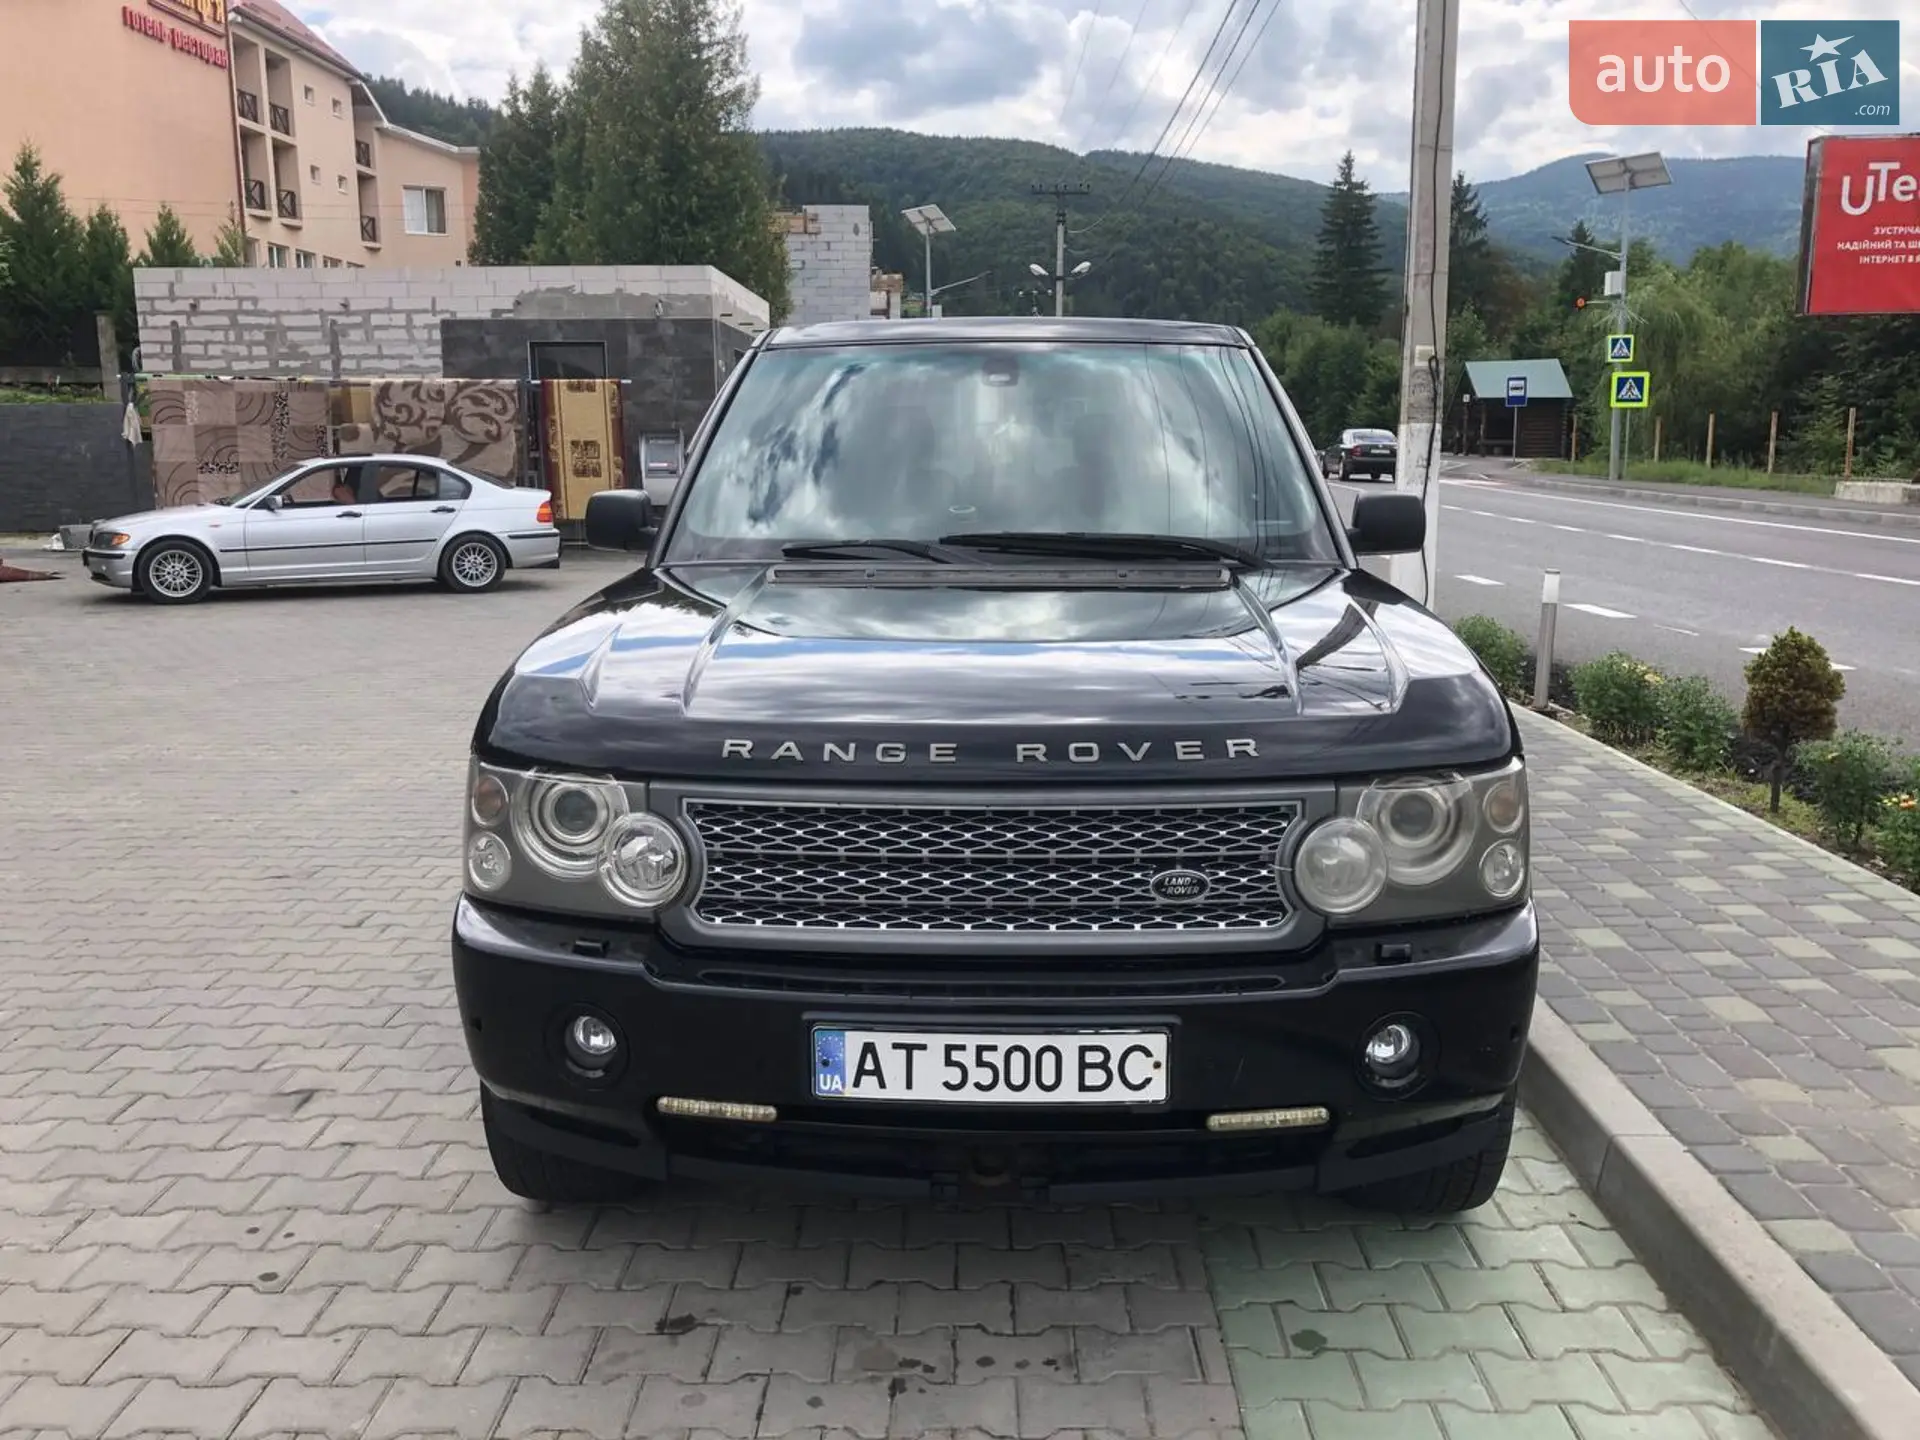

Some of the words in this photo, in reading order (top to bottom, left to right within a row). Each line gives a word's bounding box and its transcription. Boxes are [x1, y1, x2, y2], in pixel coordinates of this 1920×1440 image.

[1841, 161, 1920, 216] UTe
[1837, 240, 1892, 250] НАДІЙНИЙ
[1894, 241, 1906, 249] ТА
[1908, 240, 1920, 249] Ш
[1859, 255, 1906, 264] ІНТЕРНЕТ
[722, 739, 957, 763] RANGE
[1016, 738, 1259, 763] ROVER
[852, 1042, 927, 1089] AT
[942, 1044, 1062, 1092] 5500
[1078, 1044, 1153, 1092] BC
[819, 1074, 842, 1092] UA
